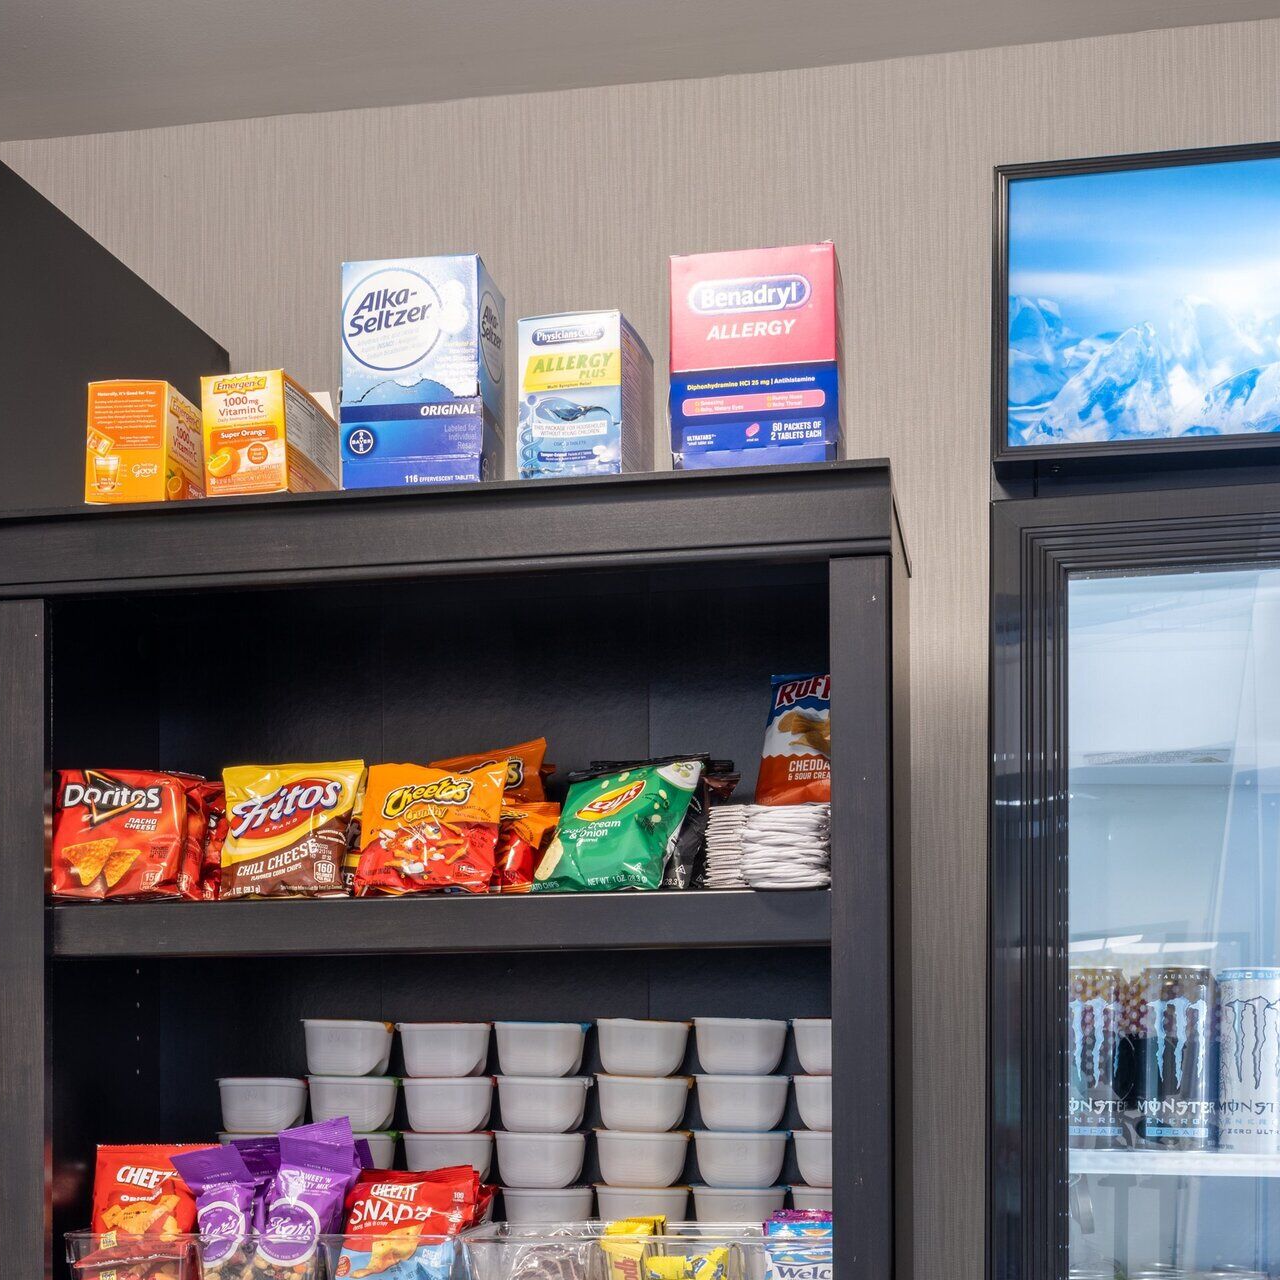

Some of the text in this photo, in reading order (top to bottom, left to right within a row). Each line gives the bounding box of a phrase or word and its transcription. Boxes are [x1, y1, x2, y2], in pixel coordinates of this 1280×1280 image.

[353, 288, 417, 315] Alka-
[701, 283, 797, 308] Benadryl
[348, 303, 432, 337] Seltzer
[707, 319, 796, 341] ALLERGY
[533, 352, 613, 373] ALLERGY
[579, 368, 606, 379] PLUS
[217, 378, 263, 391] Emergen-C
[219, 404, 264, 417] Vitamin C
[421, 404, 476, 416] ORIGINAL
[221, 429, 266, 439] Super Orange
[444, 424, 466, 432] Labeled
[448, 433, 476, 441] Individual
[405, 475, 418, 483] 116
[65, 784, 160, 808] Doritos
[384, 779, 471, 818] Cheetos
[585, 783, 645, 814] Lay's
[232, 780, 342, 838] Fritos
[124, 822, 156, 831] CHEESE
[128, 817, 157, 825] NACHO
[264, 818, 298, 833] BRAND
[237, 839, 318, 877] CHILI CHEESE
[317, 863, 333, 874] 160
[1137, 1099, 1215, 1115] MONSTER
